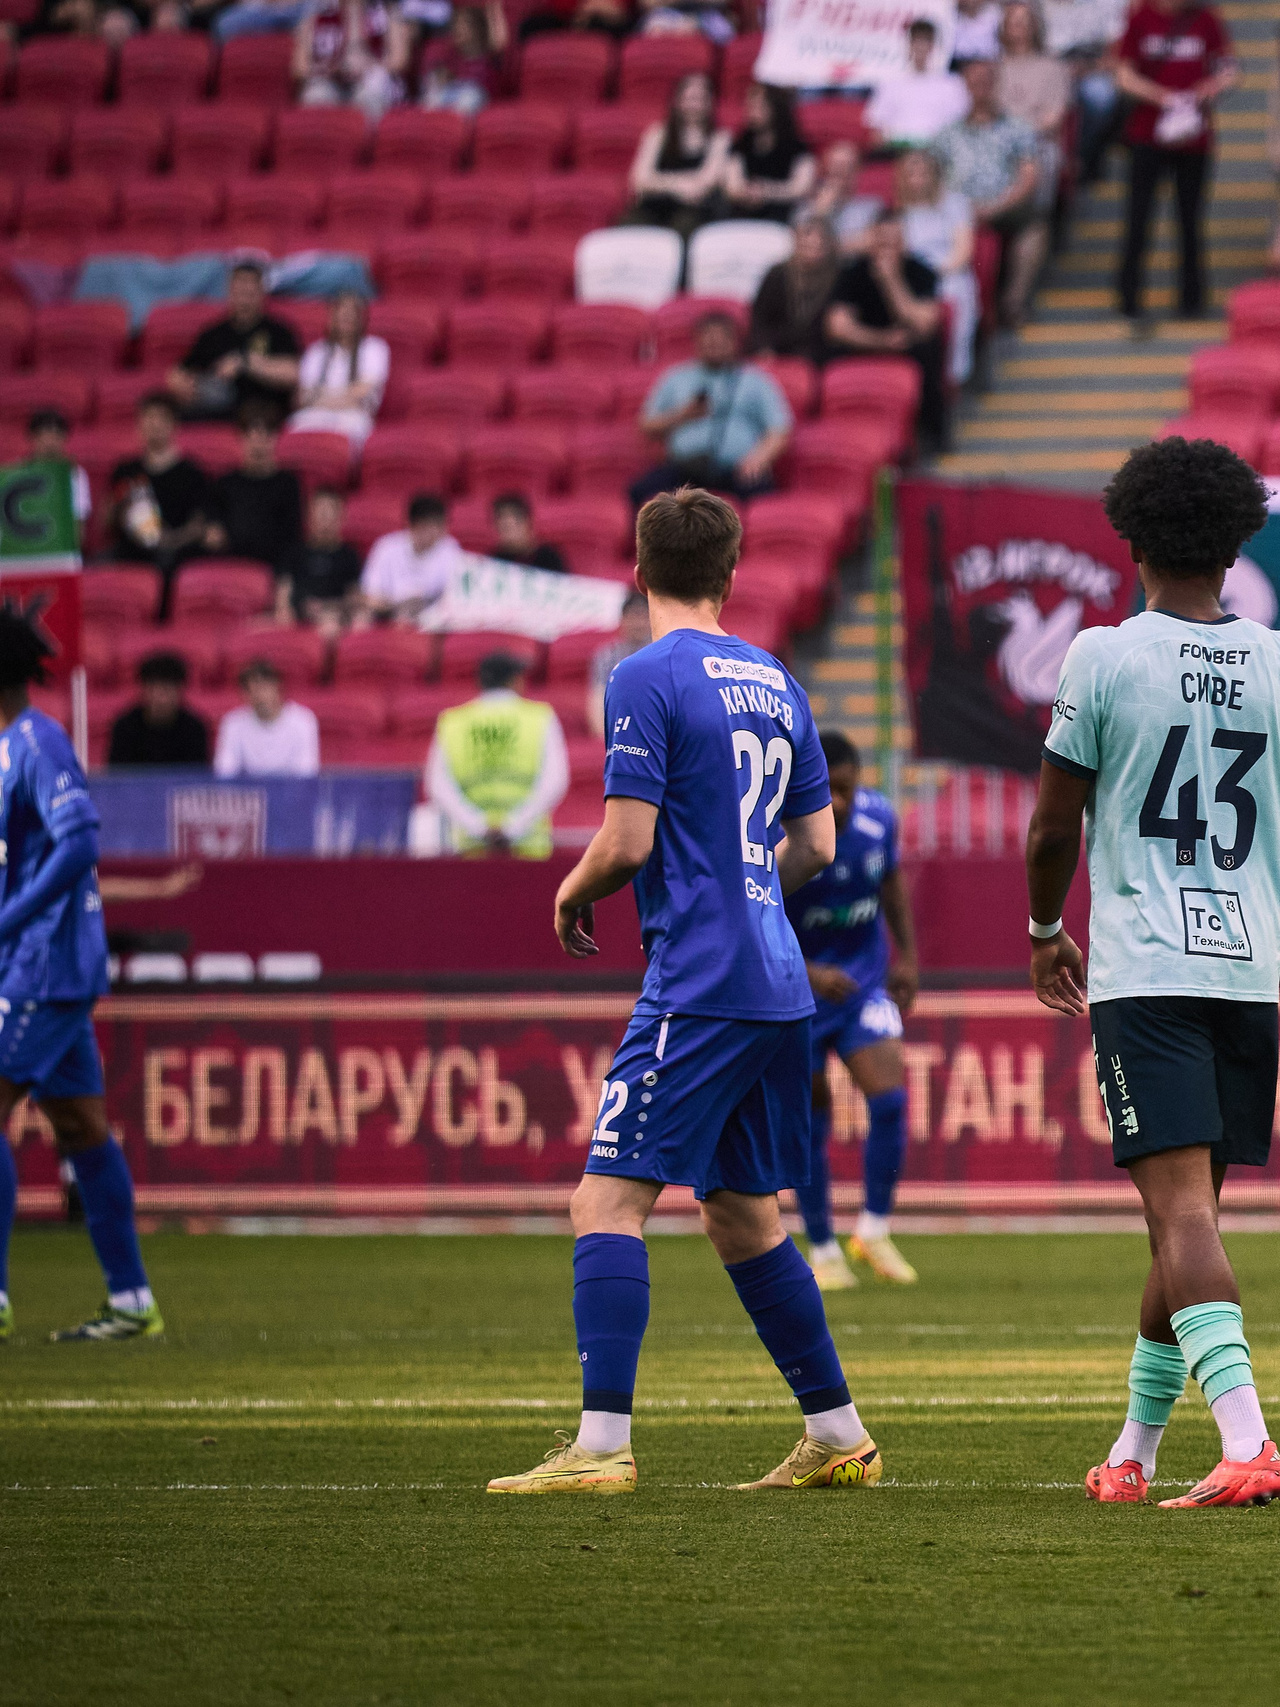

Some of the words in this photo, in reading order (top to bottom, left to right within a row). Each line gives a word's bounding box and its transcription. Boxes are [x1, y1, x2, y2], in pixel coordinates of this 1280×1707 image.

[1179, 643, 1251, 666] FONBET
[1180, 672, 1245, 711] СИВЕ
[718, 684, 794, 731] КАККОЕВ
[606, 743, 649, 758] ОРОДЕЦ
[731, 729, 793, 874] 22
[1138, 724, 1268, 871] 43
[1226, 899, 1236, 913] 43
[1192, 935, 1246, 952] Технеций
[144, 1047, 547, 1157] БЕЛАРУСЬ,
[591, 1144, 619, 1159] JAKO
